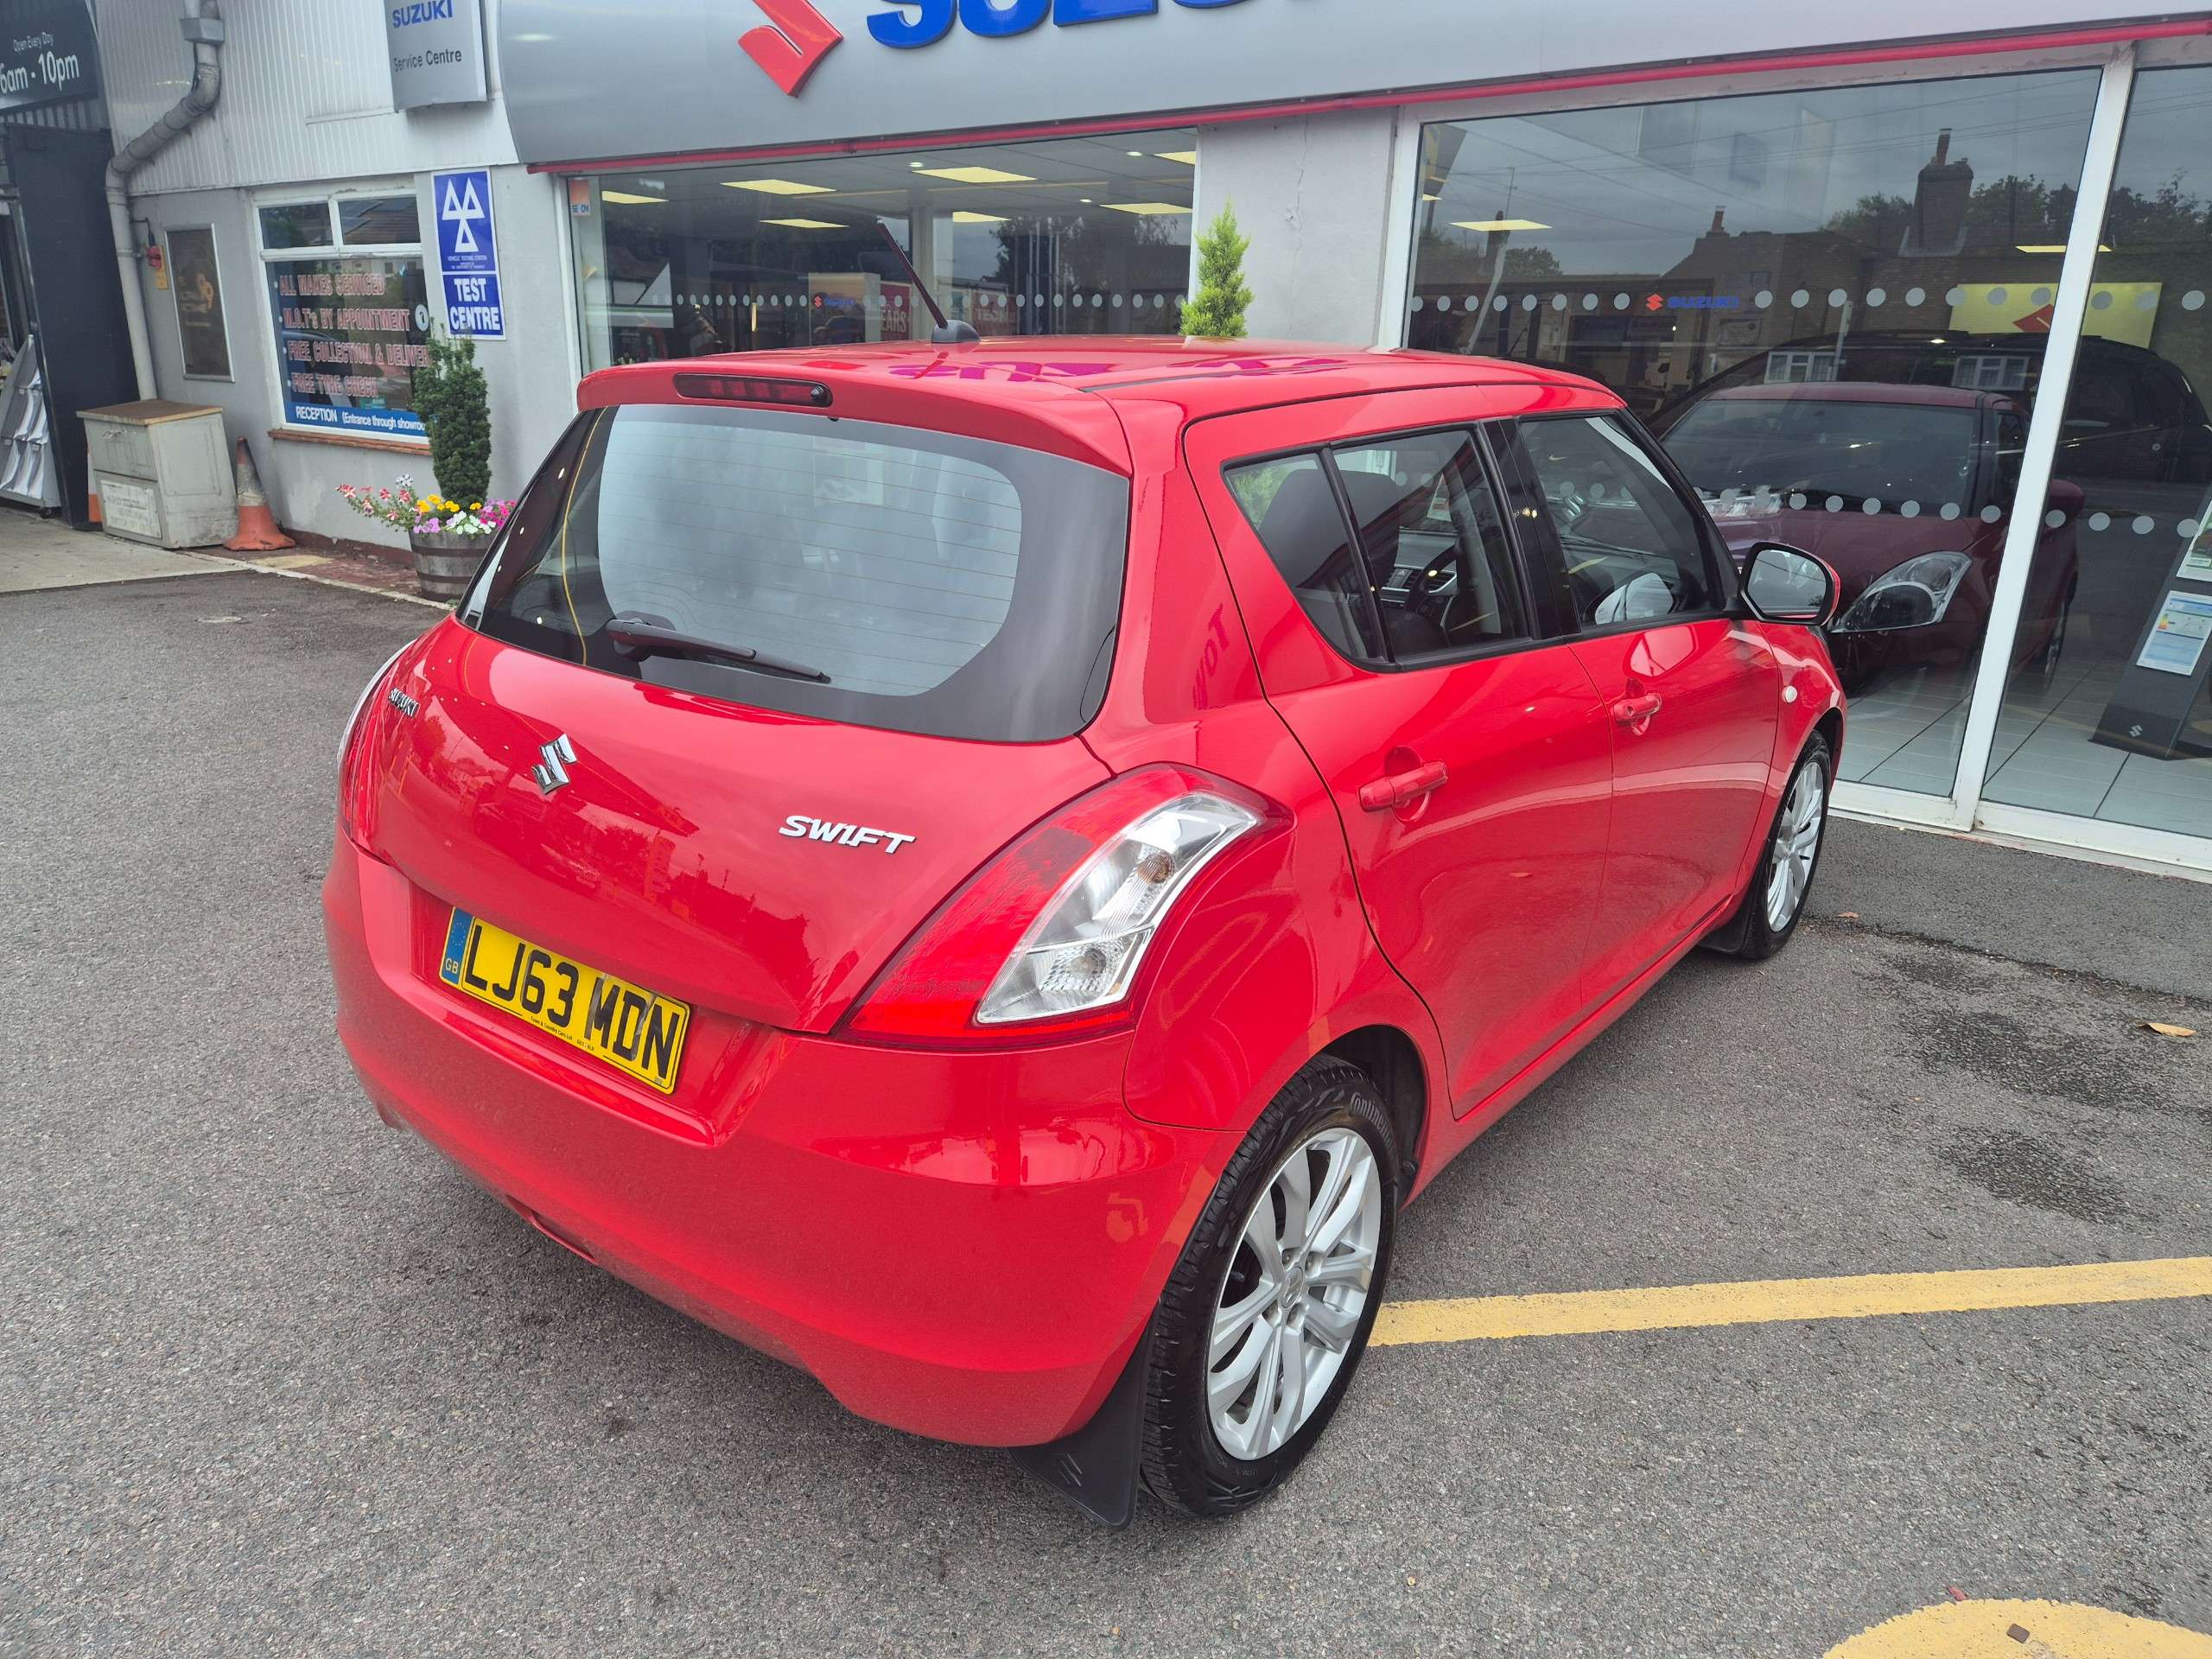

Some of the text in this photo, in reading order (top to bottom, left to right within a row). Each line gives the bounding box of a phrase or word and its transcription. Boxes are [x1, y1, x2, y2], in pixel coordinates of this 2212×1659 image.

[392, 0, 453, 28] SUZUKI
[38, 51, 79, 91] 10pm
[393, 48, 462, 73] Service Centre
[279, 273, 385, 296] ALL MAKES SERVICED
[454, 277, 486, 302] TEST
[1668, 296, 1739, 308] SUZUKI
[319, 308, 334, 329] BY
[337, 308, 410, 331] APPOINTMENT
[450, 305, 501, 330] CENTRE
[287, 340, 430, 367] FREE COLLECTION & DELIVER
[291, 372, 315, 393] FREE
[316, 374, 342, 396] TYRE
[296, 406, 337, 423] RECEPTION
[372, 415, 396, 429] through
[779, 815, 917, 855] SWIFT
[445, 957, 459, 974] GB
[465, 925, 680, 1079] LJ63 MDN
